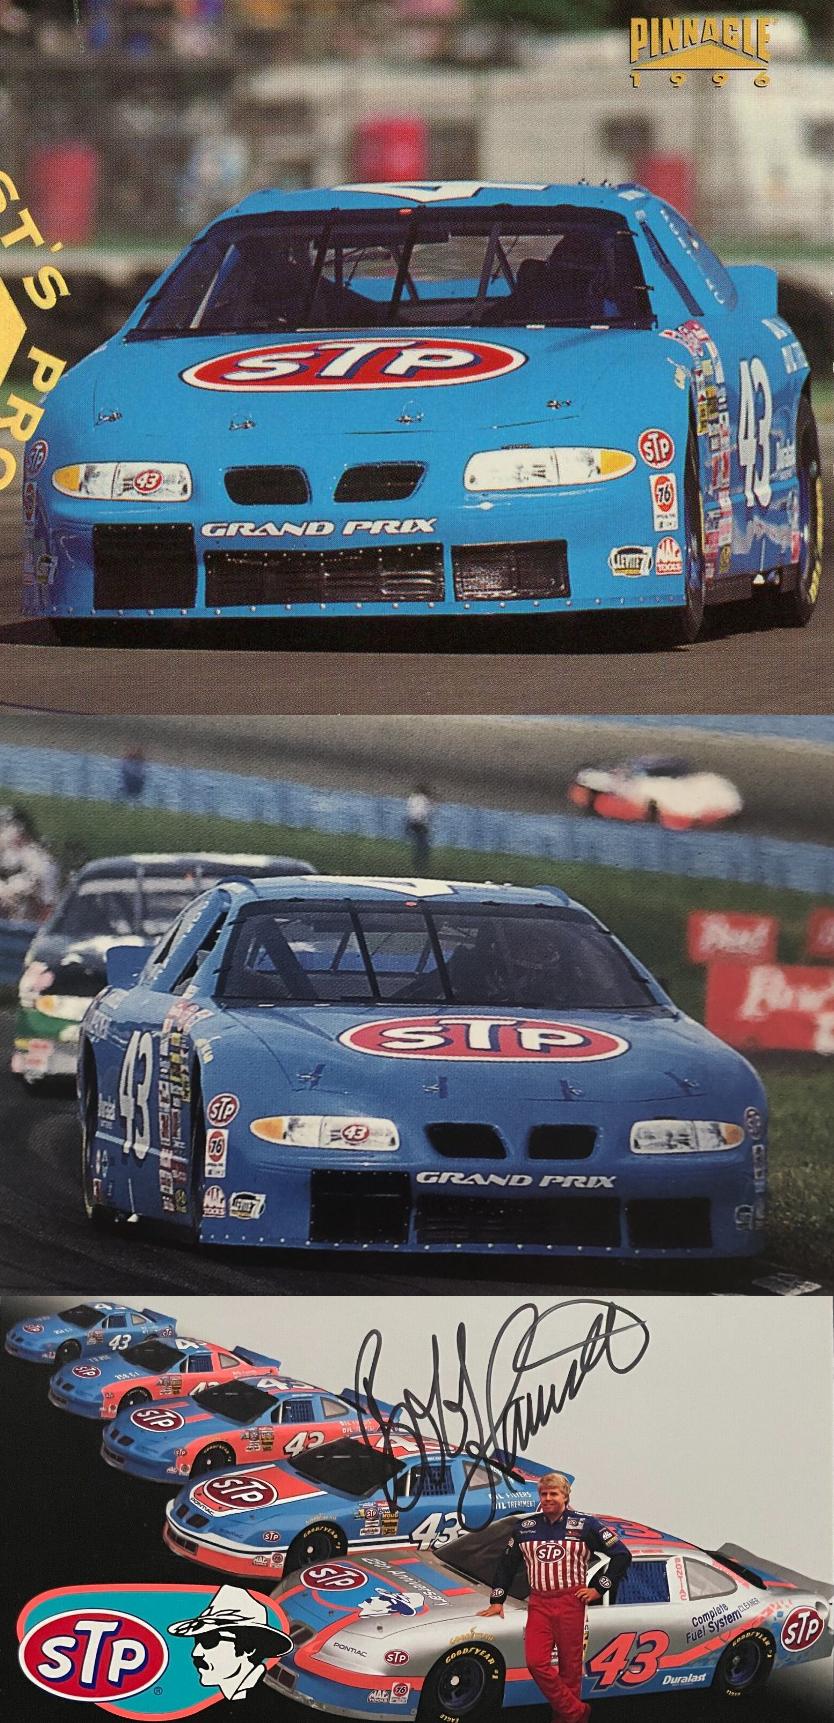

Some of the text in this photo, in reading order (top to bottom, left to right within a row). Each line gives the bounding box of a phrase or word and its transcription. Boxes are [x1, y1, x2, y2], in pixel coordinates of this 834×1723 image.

[222, 340, 482, 382] STP
[739, 357, 772, 507] 43
[644, 432, 670, 463] STP
[135, 472, 160, 490] 43
[658, 484, 671, 504] 76
[200, 517, 440, 538] GRAND PRIX
[380, 1018, 586, 1052] STP
[119, 1030, 154, 1160] 43
[209, 1096, 236, 1121] STP
[342, 1124, 370, 1141] 43
[210, 1139, 223, 1154] 76
[416, 1170, 617, 1189] GRAND PRIX
[108, 1334, 132, 1351] 43
[75, 1366, 97, 1376] STP
[136, 1409, 179, 1430] STP
[212, 1478, 268, 1502] STP
[366, 1509, 377, 1518] STP
[265, 1532, 279, 1541] STP
[539, 1544, 562, 1560] STP
[308, 1567, 360, 1587] STP
[601, 1577, 611, 1588] STP
[691, 1602, 730, 1629] Complete
[686, 1627, 707, 1644] Fuel
[707, 1608, 743, 1634] System
[784, 1610, 819, 1645] STP
[37, 1619, 148, 1691] STP
[333, 1641, 368, 1659] PONTIAC
[386, 1650, 408, 1664] STP
[445, 1647, 496, 1665] GOODYEAR
[586, 1628, 671, 1690] 43
[662, 1673, 707, 1686] Duralast
[395, 1685, 406, 1695] 76
